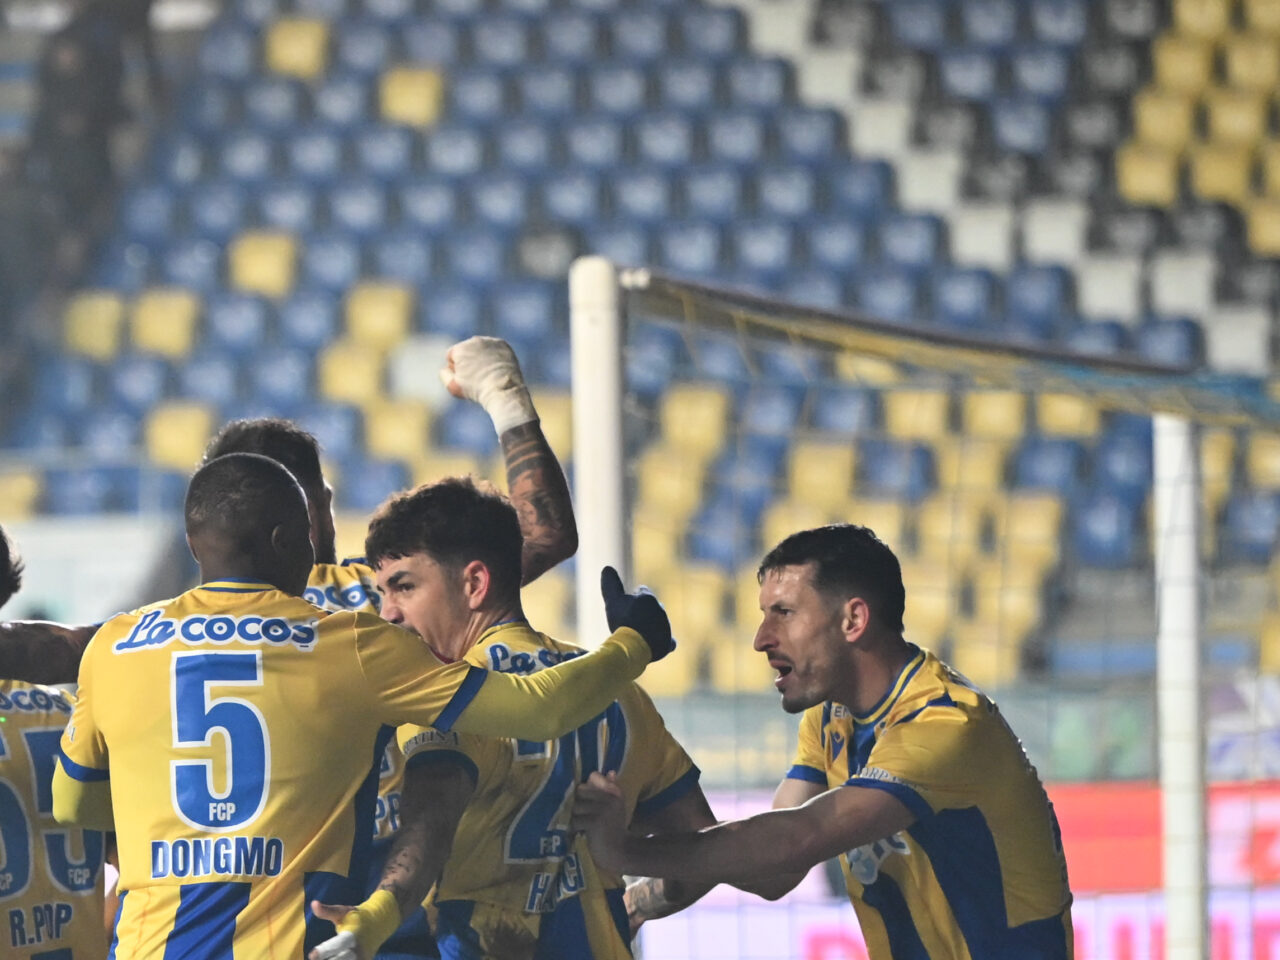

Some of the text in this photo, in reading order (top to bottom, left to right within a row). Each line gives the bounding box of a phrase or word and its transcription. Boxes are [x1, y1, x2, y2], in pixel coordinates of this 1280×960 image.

[170, 650, 272, 834] 5
[208, 802, 236, 822] FCP
[150, 836, 284, 879] DONGMO
